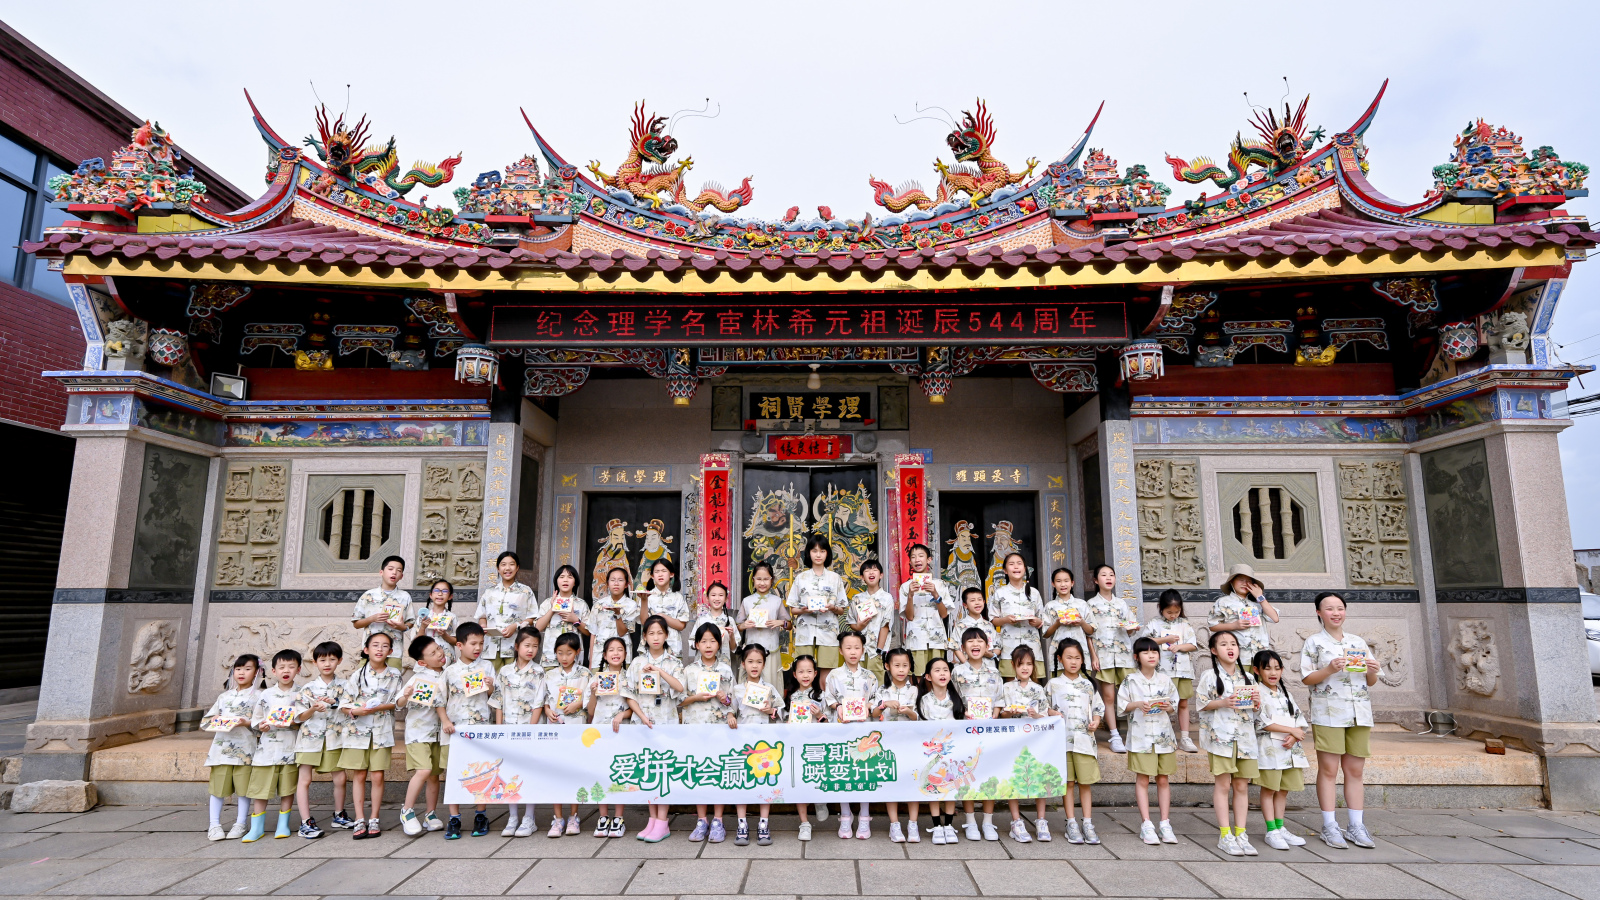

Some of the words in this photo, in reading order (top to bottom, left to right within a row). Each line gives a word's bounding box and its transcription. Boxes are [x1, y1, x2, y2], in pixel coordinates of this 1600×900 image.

[536, 307, 1098, 337] 纪念理学名宦林希元祖诞辰544周年
[708, 474, 727, 588] 金龍彩鳳配佳
[905, 475, 920, 583] 明珠碧玉
[965, 726, 984, 736] C&D
[803, 744, 851, 762] 暑期
[610, 748, 756, 797] 爱拼才会赢
[804, 761, 897, 781] 蜕变计划
